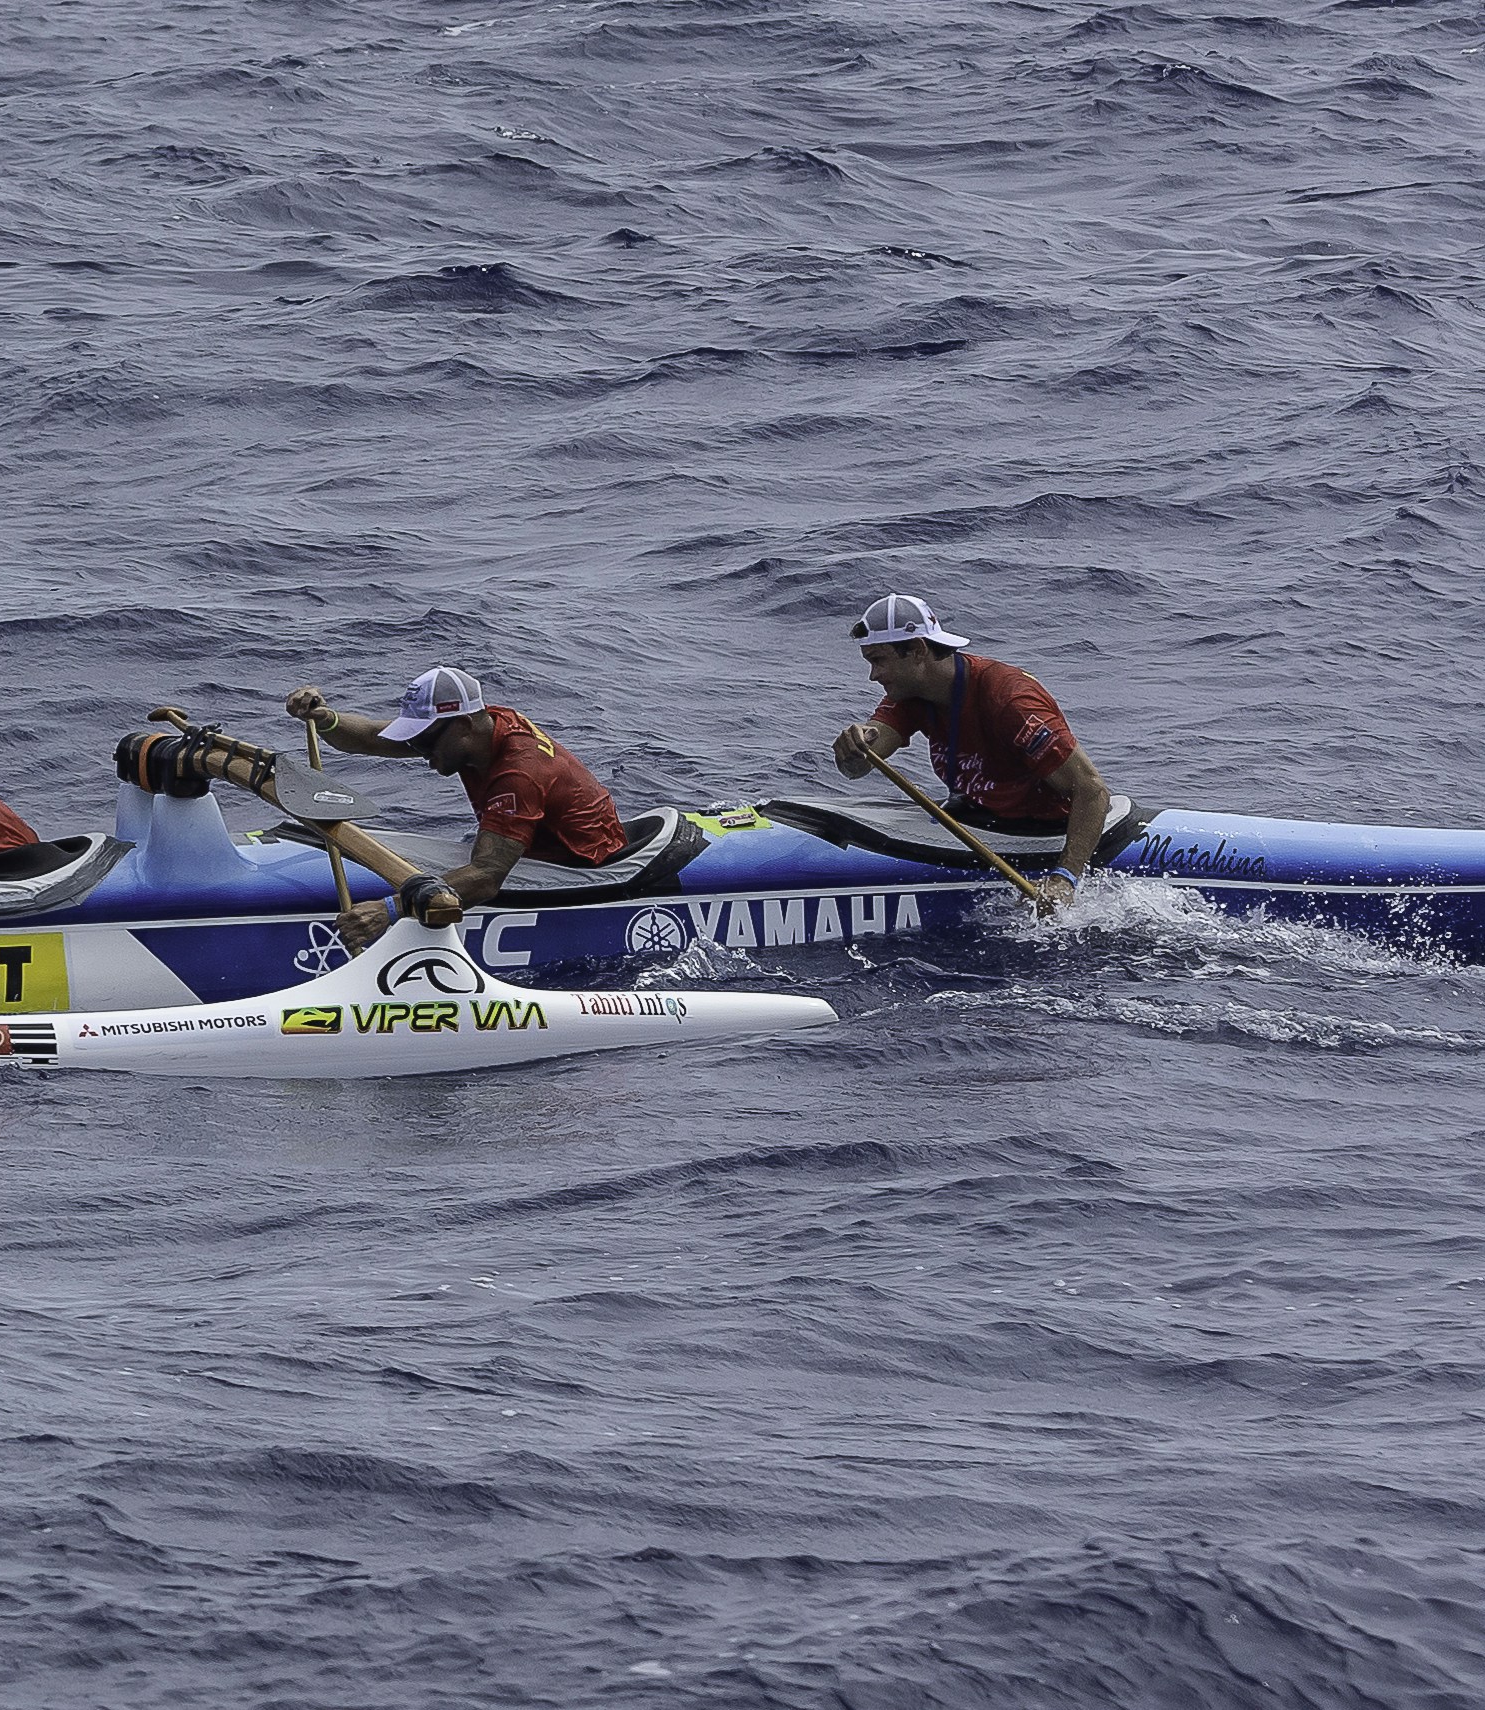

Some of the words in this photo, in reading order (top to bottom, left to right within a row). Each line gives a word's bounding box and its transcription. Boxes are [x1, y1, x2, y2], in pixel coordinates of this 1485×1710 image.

[687, 894, 922, 947] YAMAHA
[350, 1002, 460, 1033] VIPER
[570, 993, 635, 1015] Tahiti
[632, 993, 687, 1024] Infos
[101, 1020, 195, 1036] MITSUBISHI
[199, 1014, 267, 1030] MOTORS
